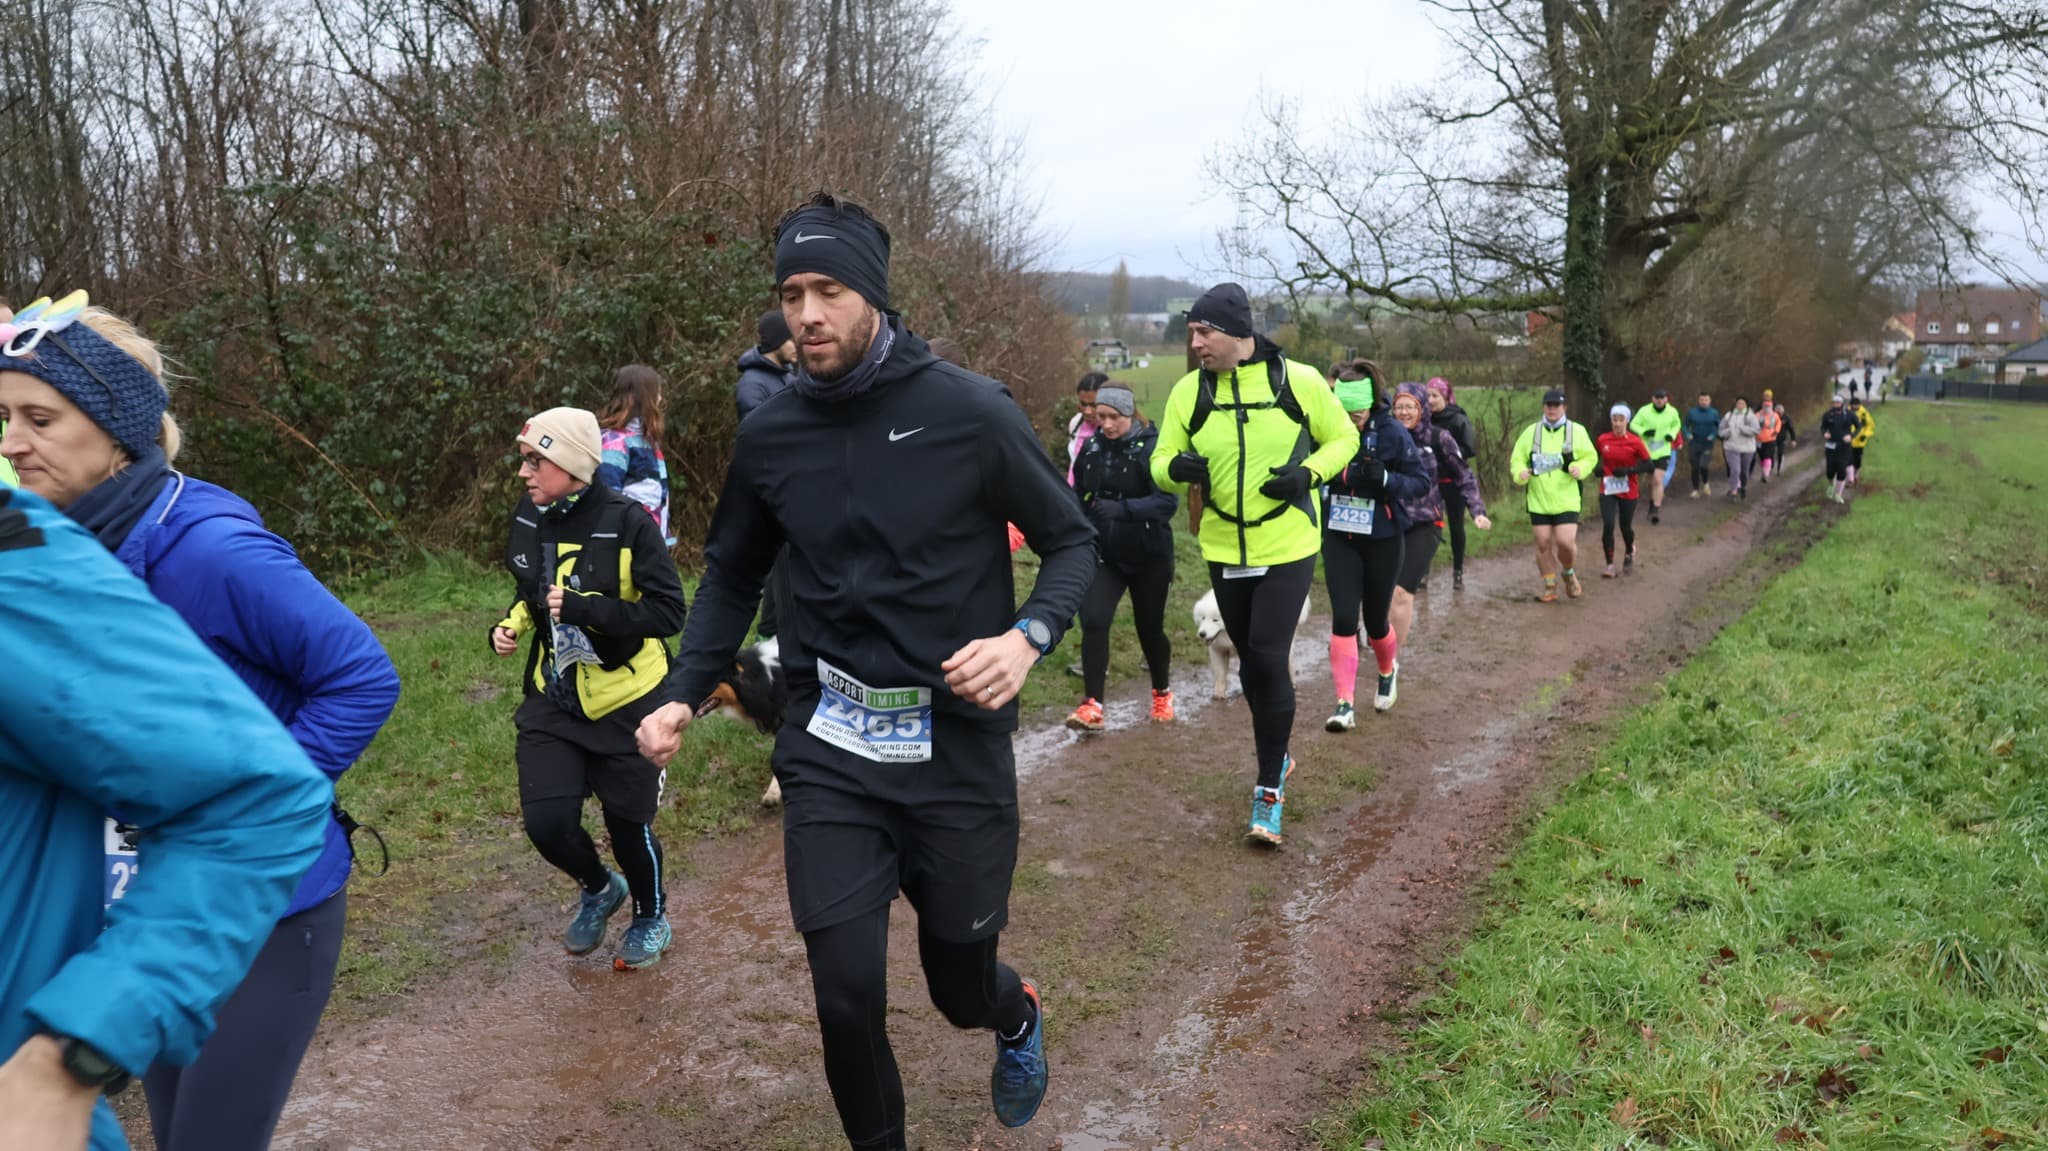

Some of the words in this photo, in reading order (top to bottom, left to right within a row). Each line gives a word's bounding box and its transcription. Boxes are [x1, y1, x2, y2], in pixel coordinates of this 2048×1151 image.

[1332, 507, 1370, 523] 2429
[828, 671, 863, 700] ASPORT
[867, 692, 910, 707] TIMING
[825, 692, 922, 738] 2465
